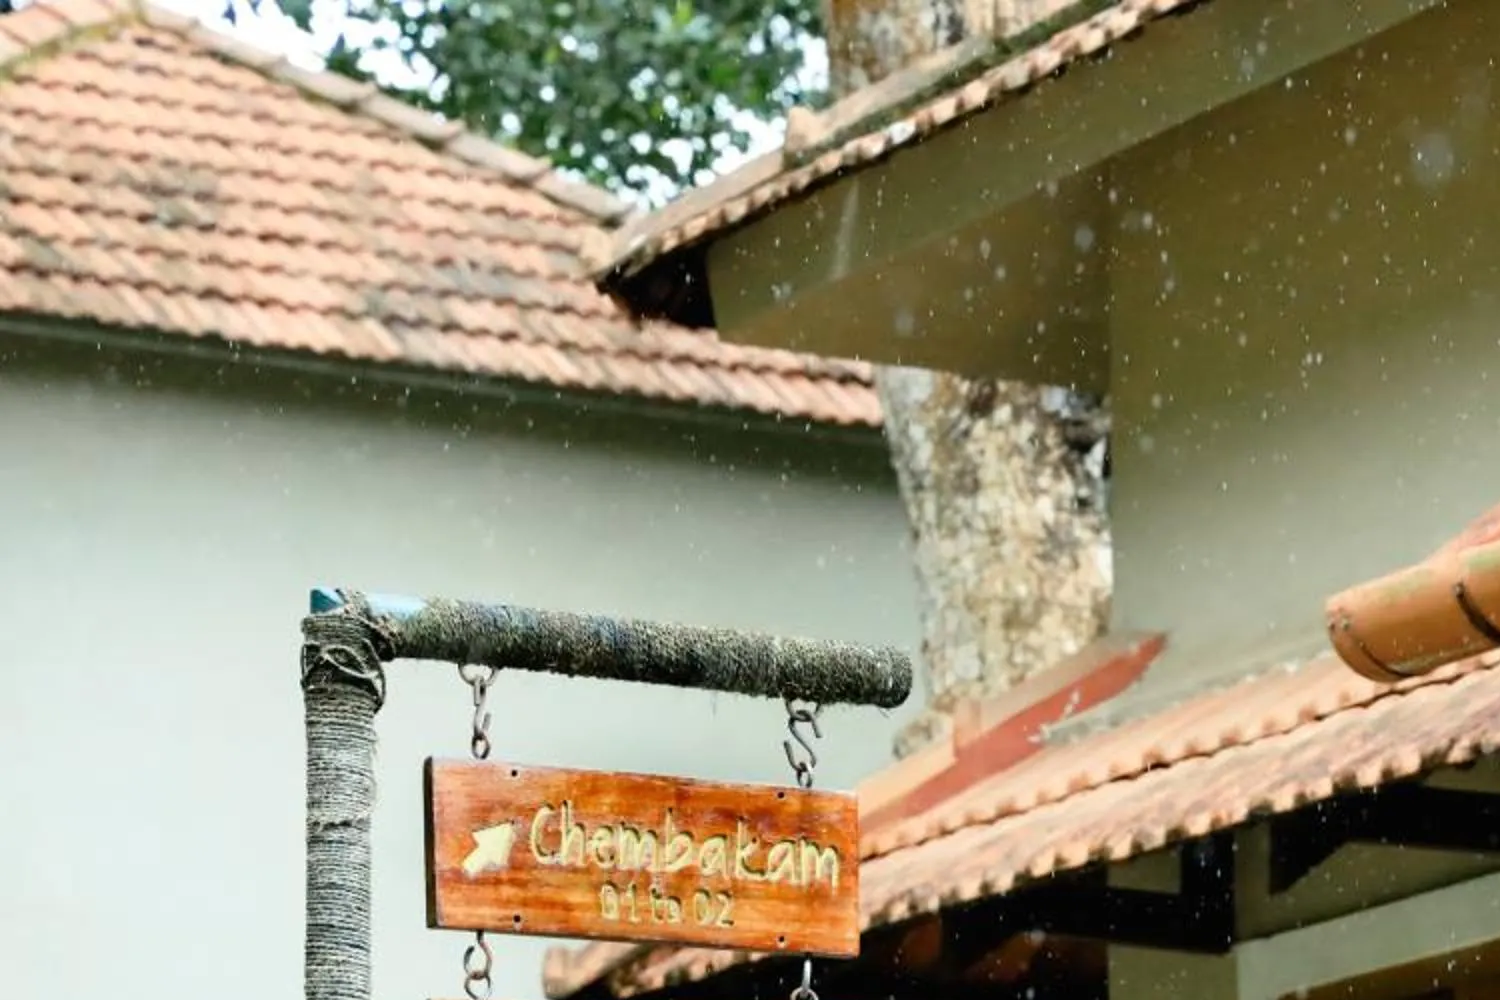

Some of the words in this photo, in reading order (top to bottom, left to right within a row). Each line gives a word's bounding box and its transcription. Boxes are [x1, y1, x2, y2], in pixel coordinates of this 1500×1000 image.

[528, 800, 841, 891] Chembakam
[600, 882, 640, 924] 01
[650, 884, 682, 925] to
[694, 887, 736, 928] 02
